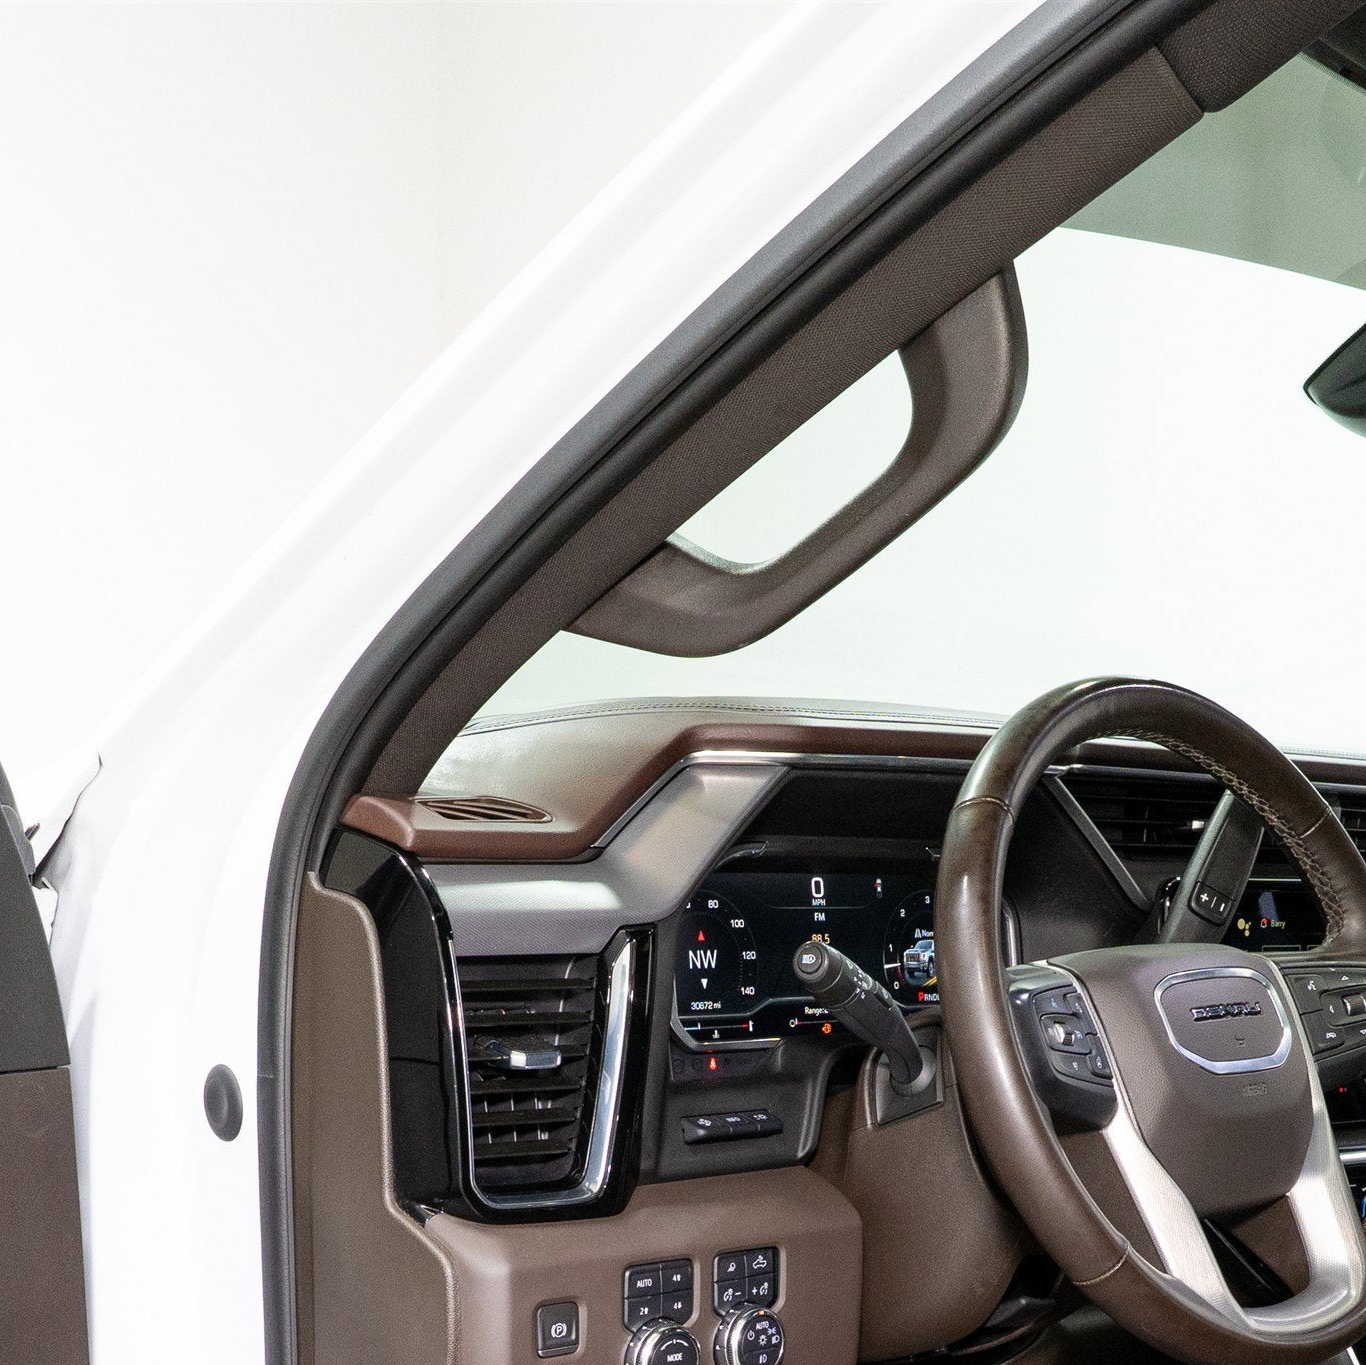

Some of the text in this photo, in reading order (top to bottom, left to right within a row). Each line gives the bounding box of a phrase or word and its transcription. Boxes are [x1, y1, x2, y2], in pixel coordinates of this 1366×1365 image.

[811, 877, 824, 898] 0
[708, 900, 719, 909] 80
[925, 896, 930, 904] 3
[814, 912, 826, 921] FM
[900, 909, 906, 917] 2
[730, 919, 745, 928] 100
[688, 949, 717, 970] NW
[742, 951, 756, 960] 120
[894, 981, 900, 990] 0
[740, 986, 755, 995] 140
[713, 1001, 722, 1009] mi
[636, 1278, 653, 1288] AUTO
[755, 1320, 770, 1331] AUTO
[666, 1352, 683, 1363] MODE
